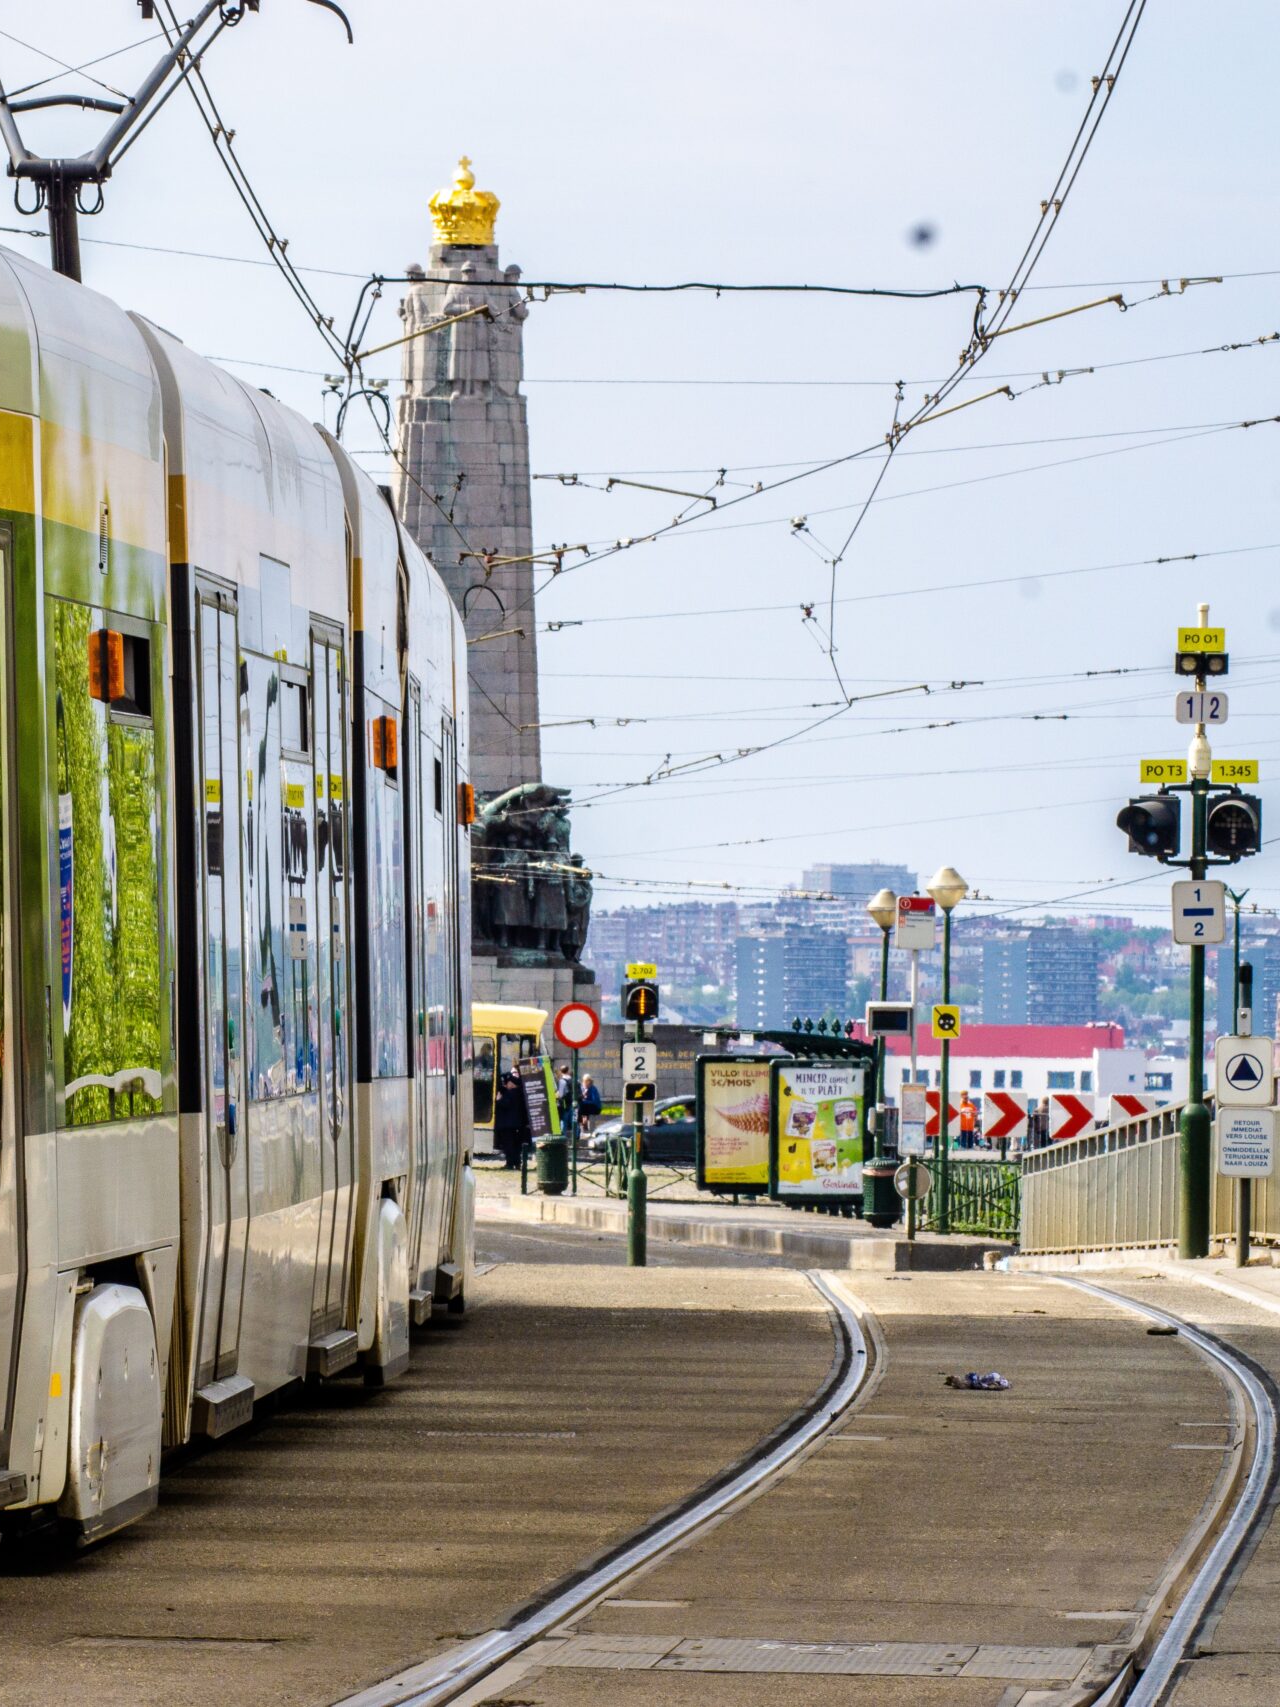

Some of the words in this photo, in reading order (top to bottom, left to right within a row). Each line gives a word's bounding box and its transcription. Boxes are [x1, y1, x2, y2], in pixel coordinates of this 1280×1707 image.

[1184, 634, 1200, 643] PO
[1186, 696, 1193, 718] 1
[1210, 696, 1220, 719] 2
[1146, 765, 1164, 776] PO
[1168, 765, 1183, 776] T3
[1219, 765, 1251, 776] 1.345
[1194, 888, 1201, 902] 1
[1194, 922, 1204, 936] 2
[632, 967, 653, 975] 2.702
[634, 1056, 645, 1071] 2
[795, 1073, 827, 1084] MINCIR
